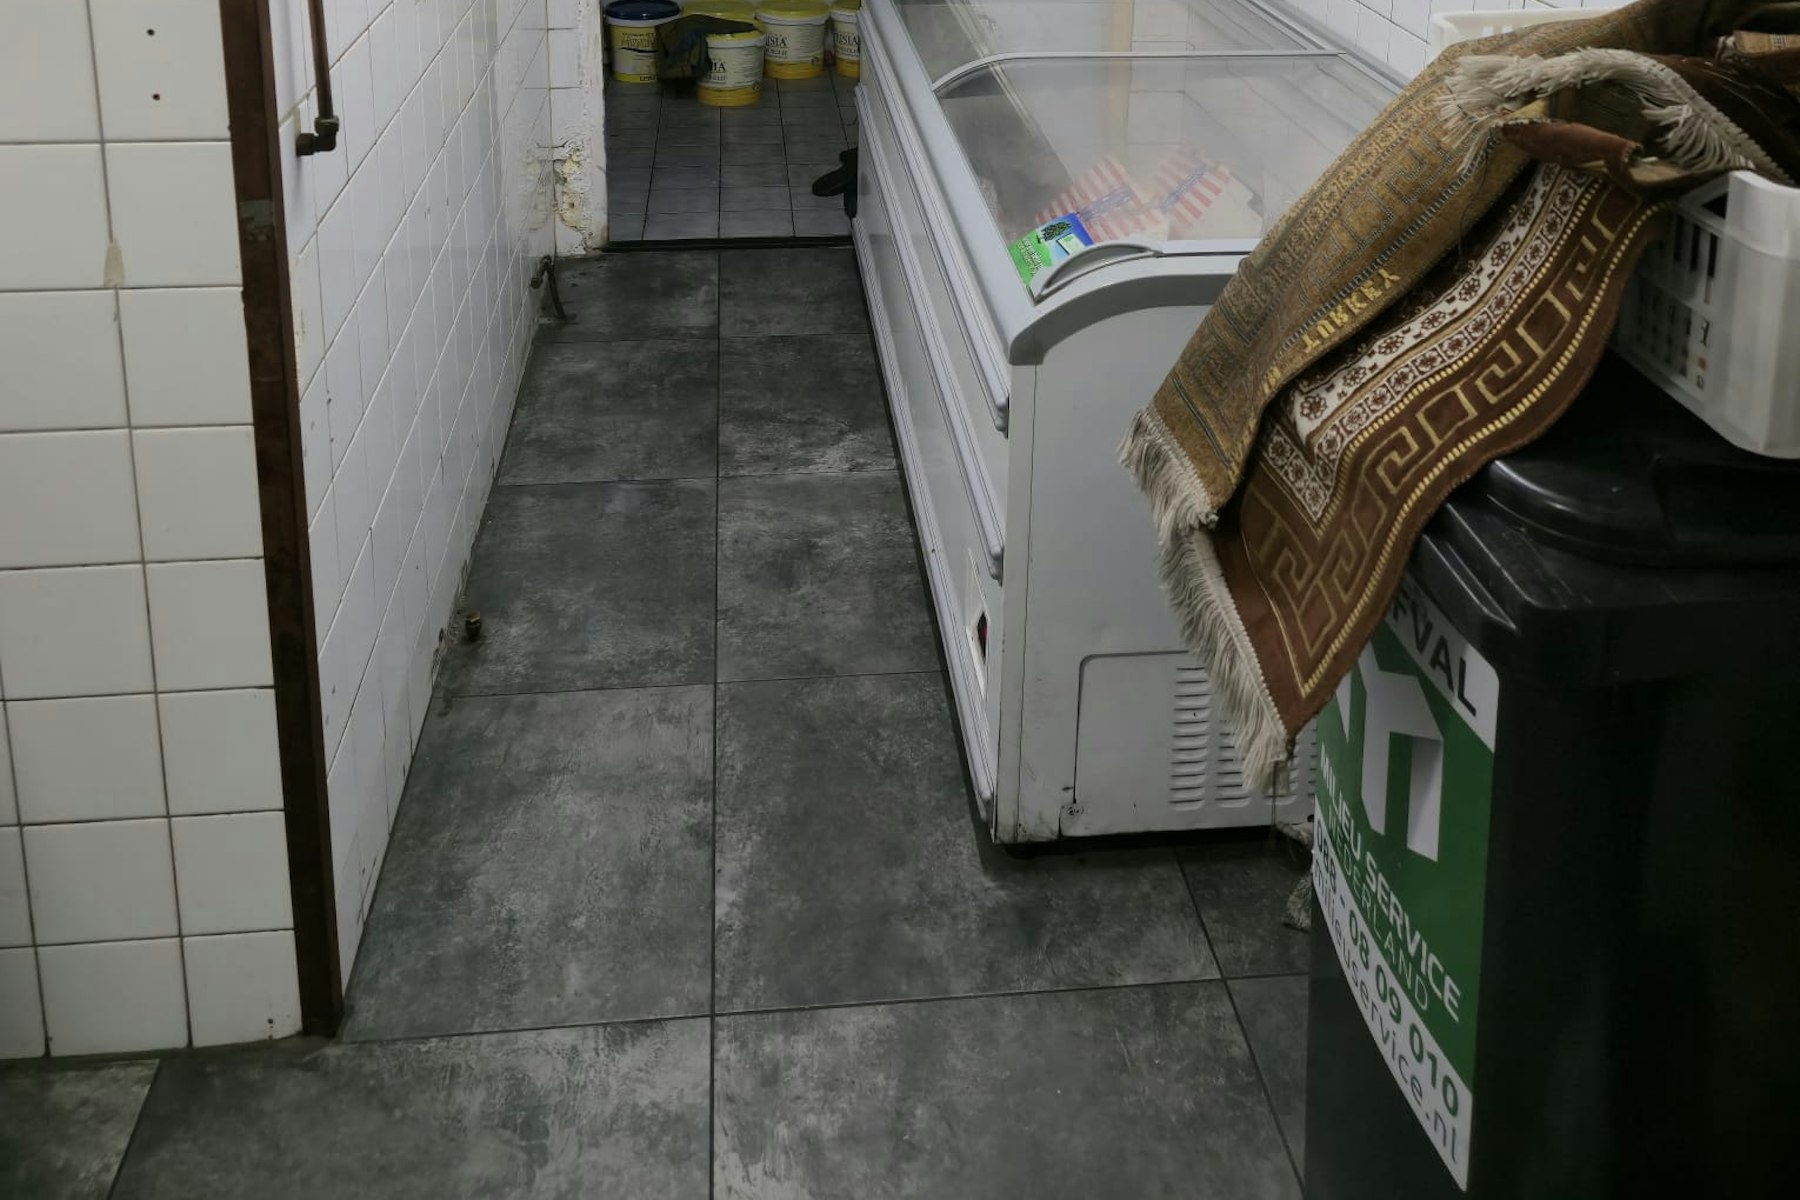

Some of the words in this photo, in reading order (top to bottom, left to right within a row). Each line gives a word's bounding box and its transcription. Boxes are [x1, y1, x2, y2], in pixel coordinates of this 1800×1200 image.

[1392, 585, 1477, 718] FVAL
[1315, 858, 1457, 1164] milieuservice.nl
[1316, 819, 1337, 895] 088
[1349, 908, 1370, 972] 08
[1375, 963, 1402, 1025] 09
[1409, 1022, 1459, 1119] 010
[1320, 741, 1362, 862] MILIEU
[1365, 850, 1462, 1023] SERVICE
[1328, 803, 1428, 1012] NEDERLAND
